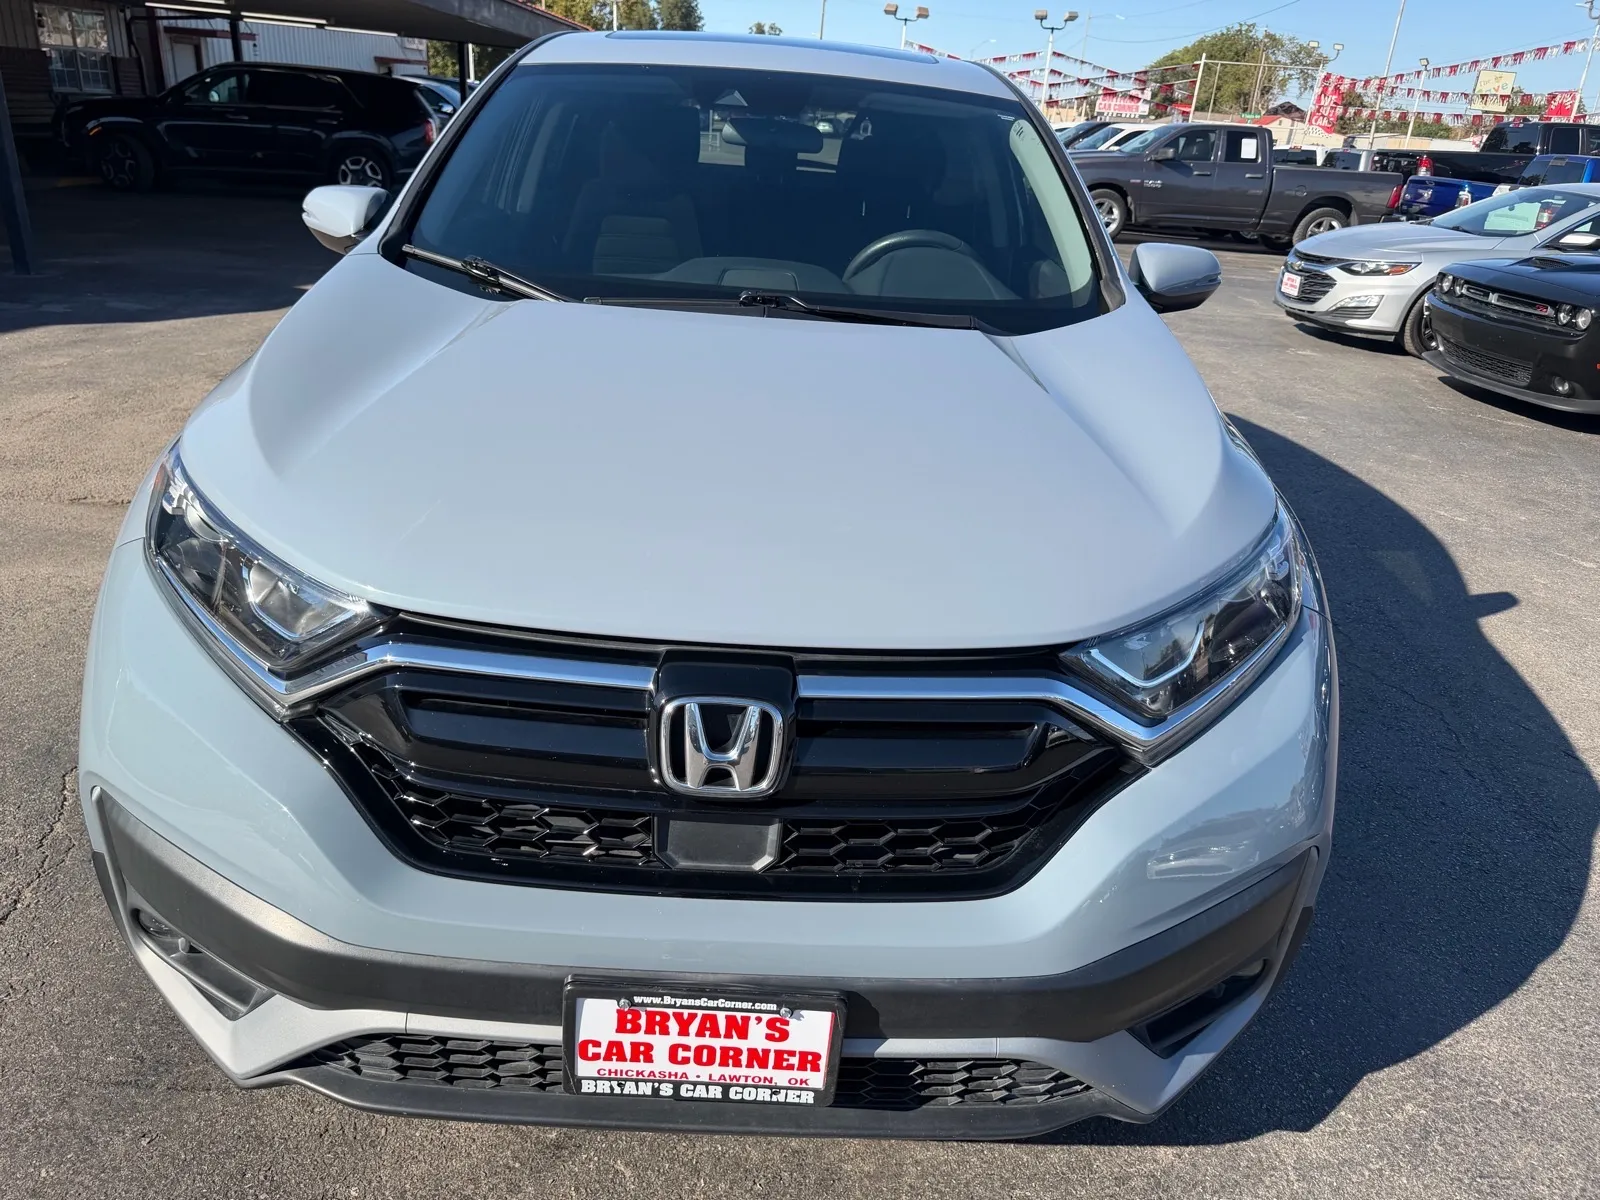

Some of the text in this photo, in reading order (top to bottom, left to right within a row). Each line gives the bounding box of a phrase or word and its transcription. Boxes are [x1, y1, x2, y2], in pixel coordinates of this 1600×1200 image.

[1312, 116, 1335, 127] CARS
[633, 995, 777, 1011] www.BryansCarCorner.com
[615, 1008, 791, 1043] BRYAN'S
[578, 1039, 822, 1073] CAR CORNER
[596, 1067, 811, 1087] CHICKASHA LAWTON, OK
[581, 1079, 815, 1104] BRYAN'S CAR CORNER
